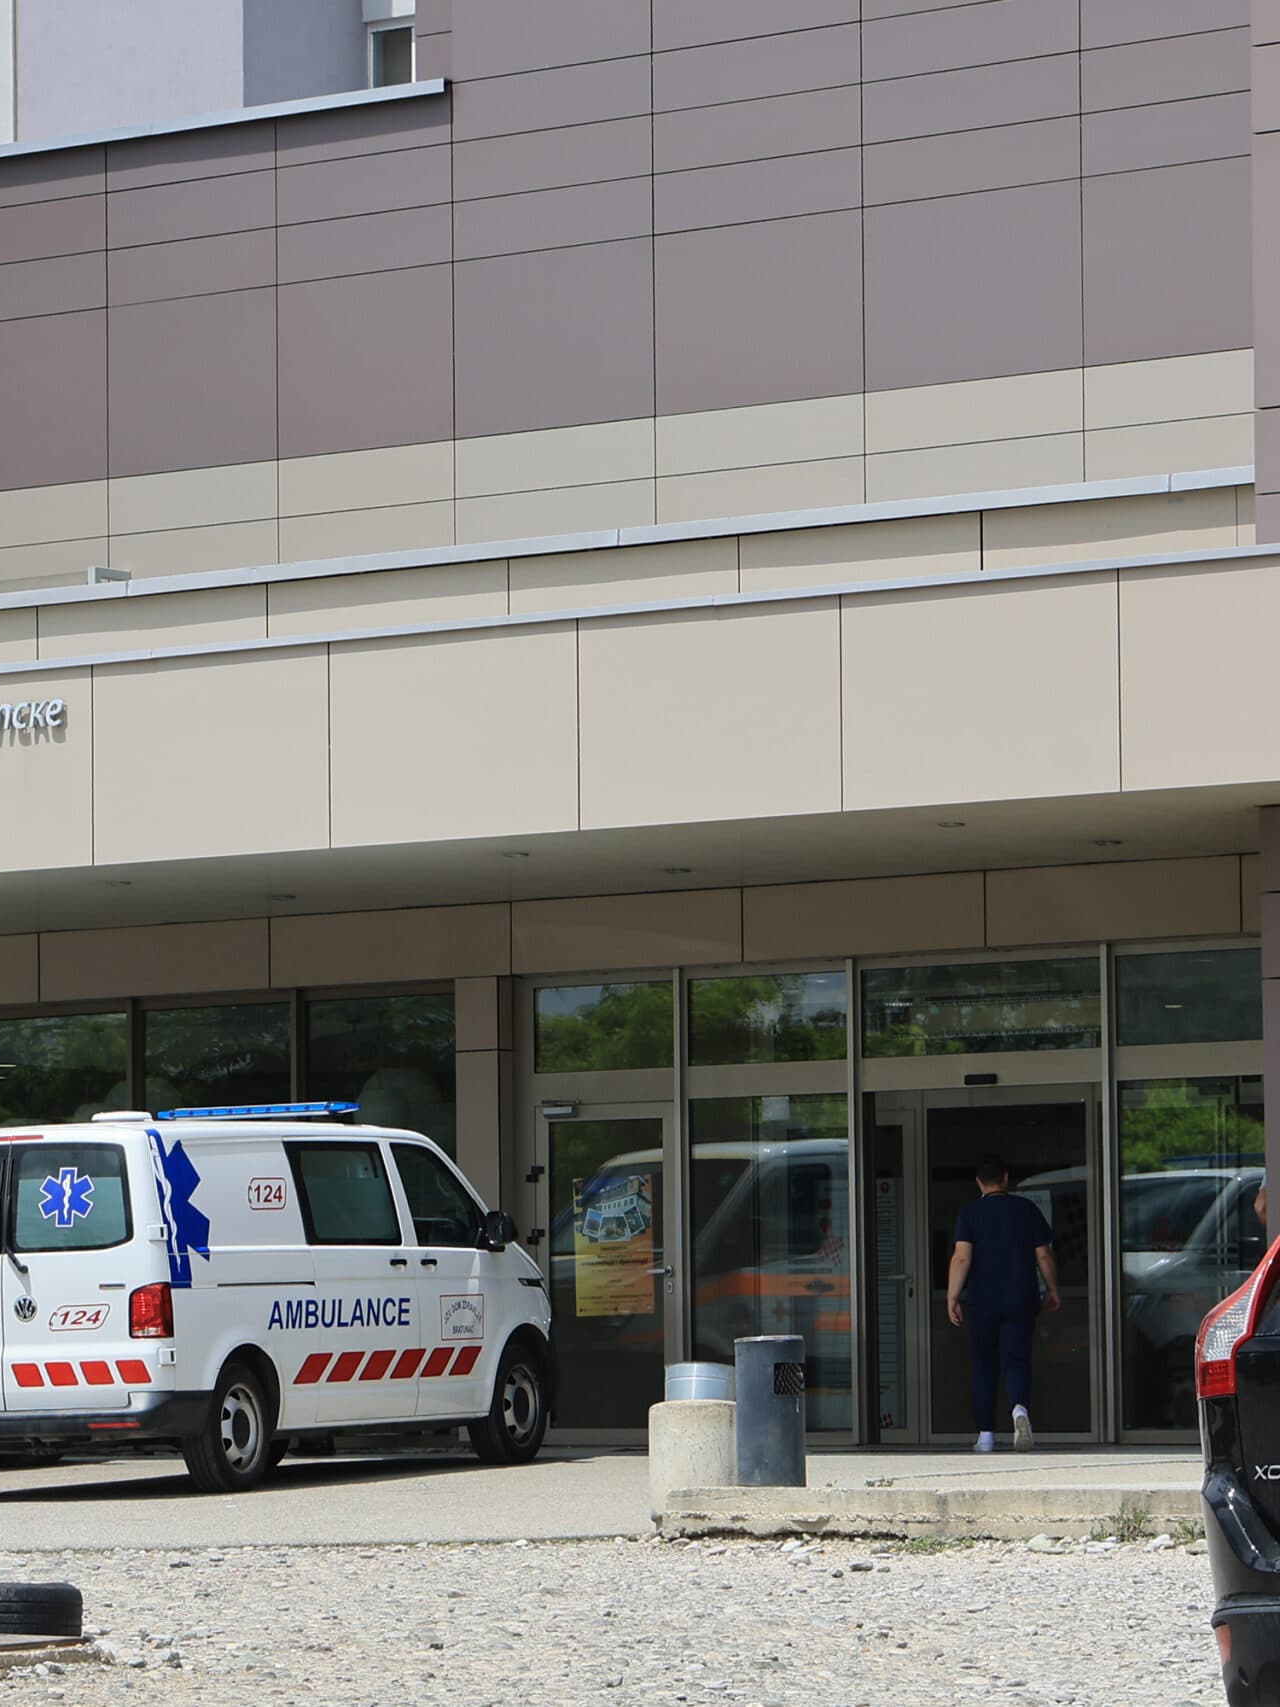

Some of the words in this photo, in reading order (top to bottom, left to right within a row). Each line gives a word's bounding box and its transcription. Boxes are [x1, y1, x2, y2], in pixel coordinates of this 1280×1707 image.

[254, 1184, 283, 1203] 124
[60, 1310, 102, 1326] 124
[268, 1298, 411, 1330] AMBULANCE
